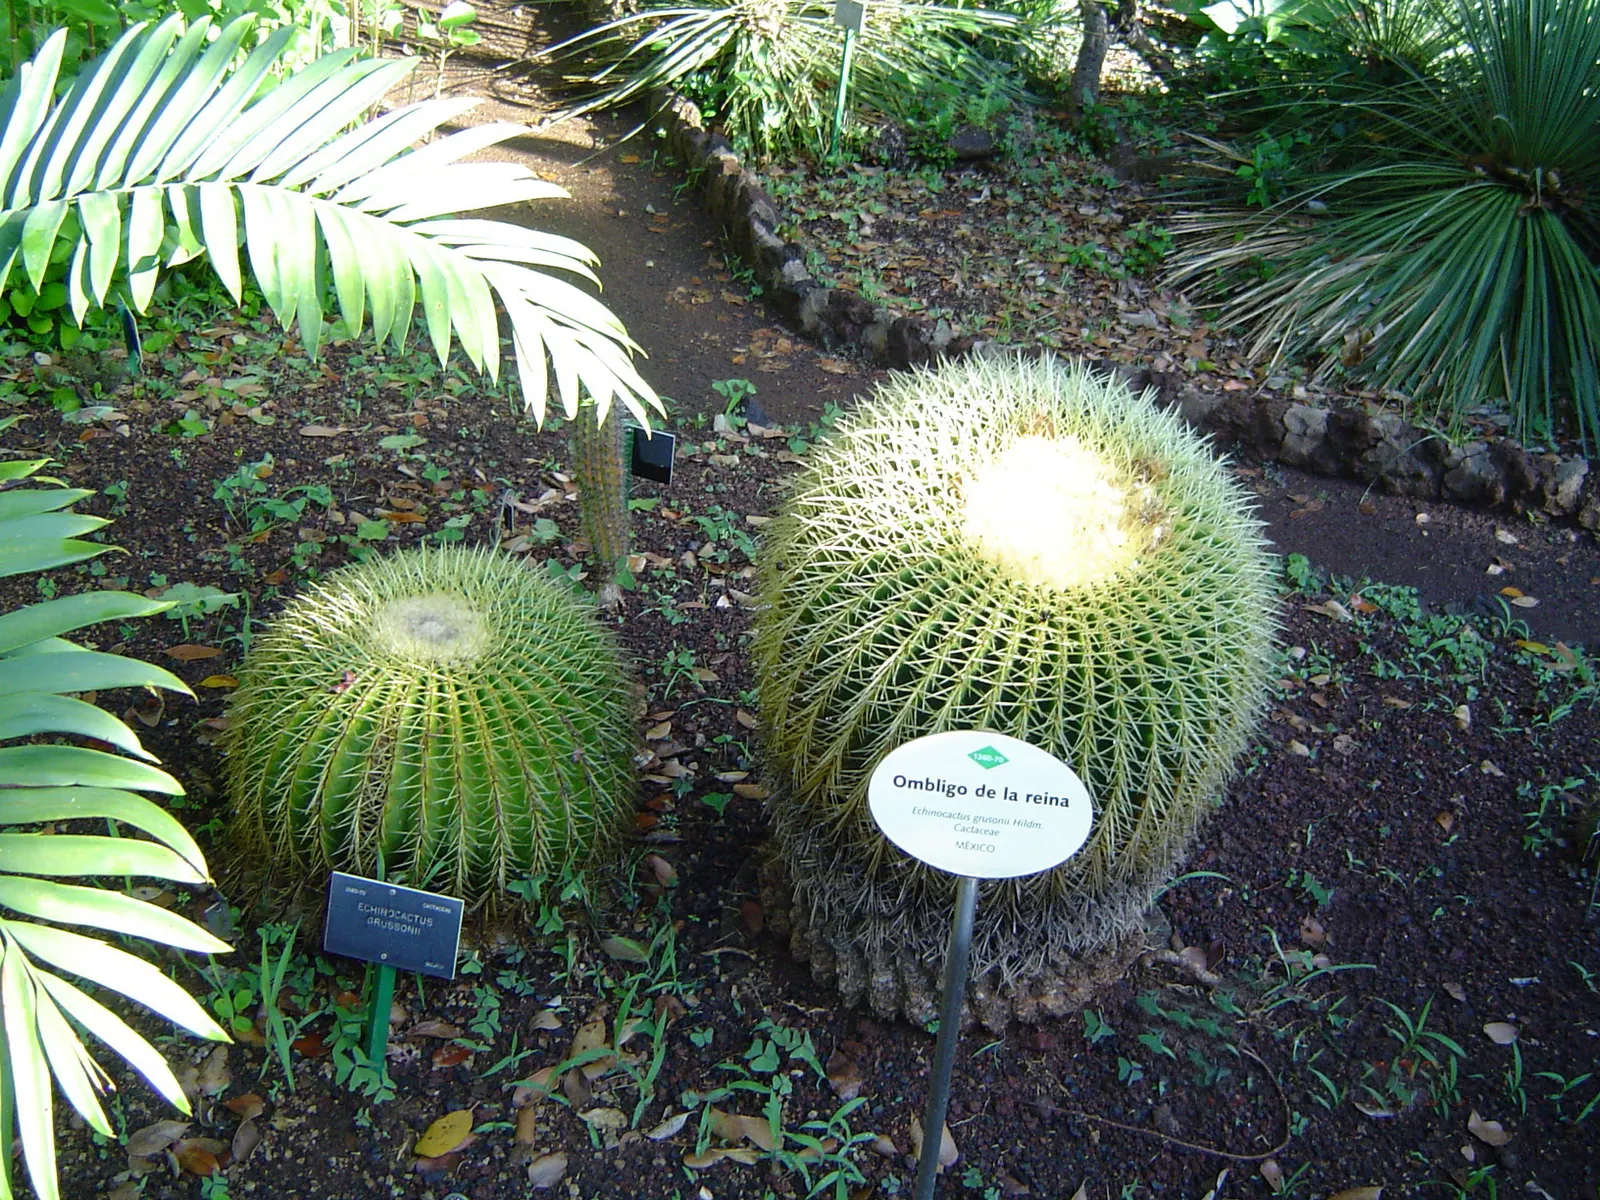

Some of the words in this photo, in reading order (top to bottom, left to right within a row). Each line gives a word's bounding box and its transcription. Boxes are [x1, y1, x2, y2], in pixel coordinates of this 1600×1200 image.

[893, 775, 968, 798] Ombligo
[975, 784, 996, 799] de
[1003, 787, 1018, 802] la
[1026, 792, 1070, 808] reina
[911, 806, 971, 821] Echinocactus
[973, 814, 1010, 826] grusonii
[1012, 818, 1043, 830] Hildm.
[953, 823, 1000, 837] Cactaceae
[955, 840, 996, 854] MÉXICO
[357, 902, 433, 927] ECHINOCACTUS
